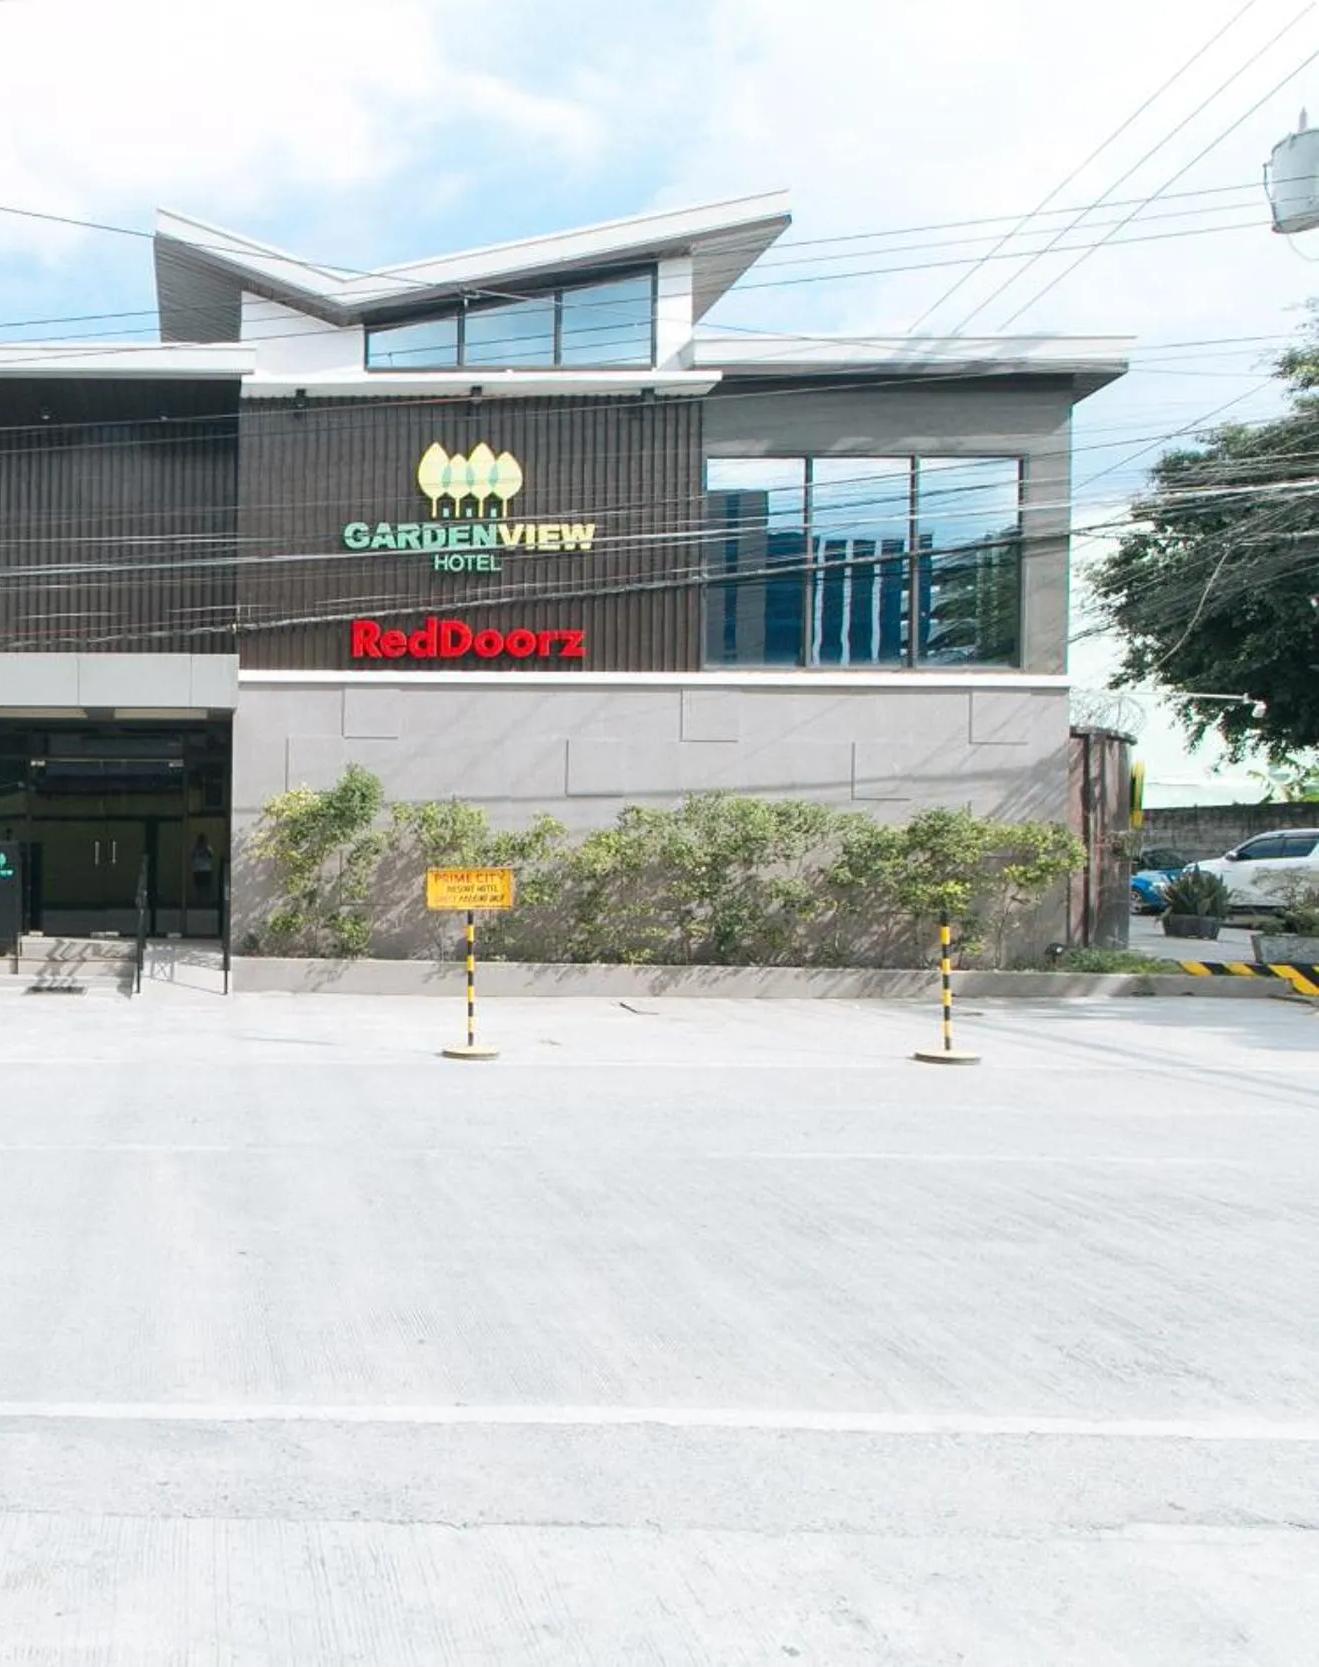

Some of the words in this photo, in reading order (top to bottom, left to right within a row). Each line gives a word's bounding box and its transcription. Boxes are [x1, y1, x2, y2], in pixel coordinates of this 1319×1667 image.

[342, 521, 596, 551] GARDENVIEW
[433, 553, 503, 572] HOTEL
[350, 616, 587, 659] RedDoorz
